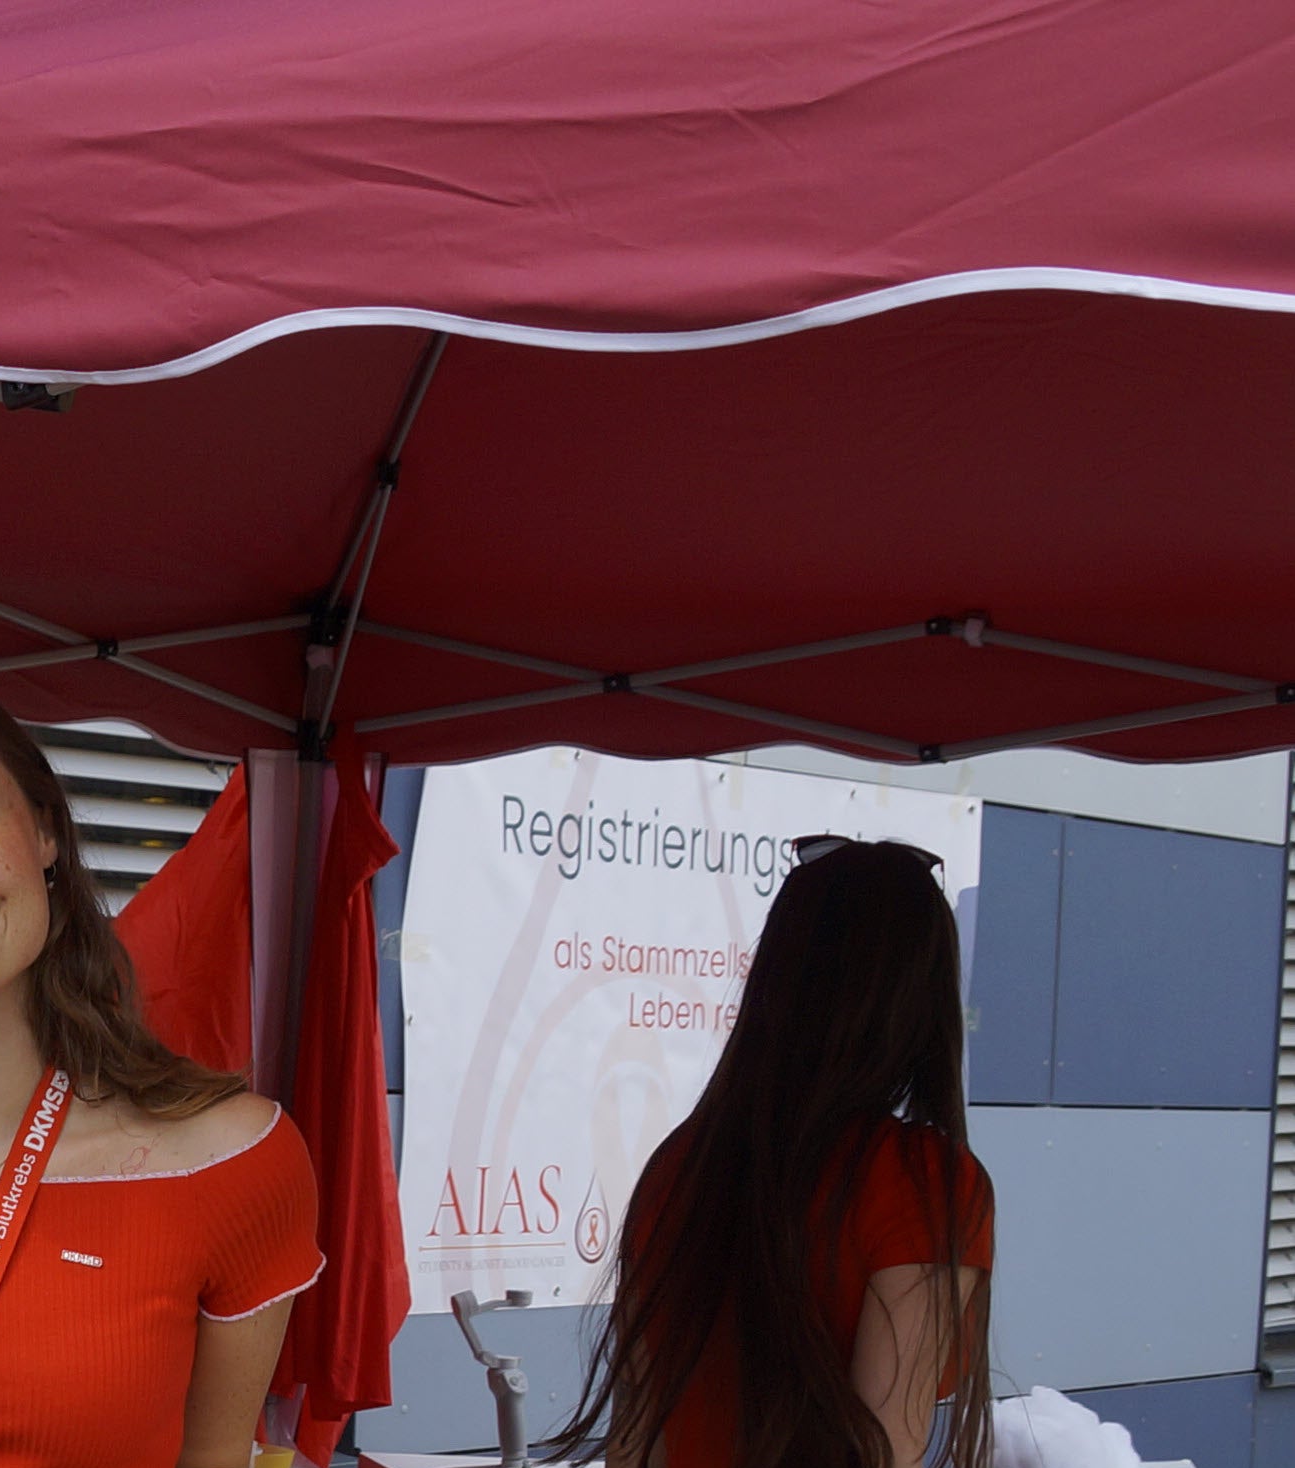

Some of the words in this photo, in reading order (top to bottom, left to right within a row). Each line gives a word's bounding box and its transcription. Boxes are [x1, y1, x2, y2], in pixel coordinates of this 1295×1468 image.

[554, 931, 592, 971] als
[628, 992, 706, 1032] Leben
[23, 1085, 65, 1153] DKMS
[425, 1164, 562, 1237] AIAS
